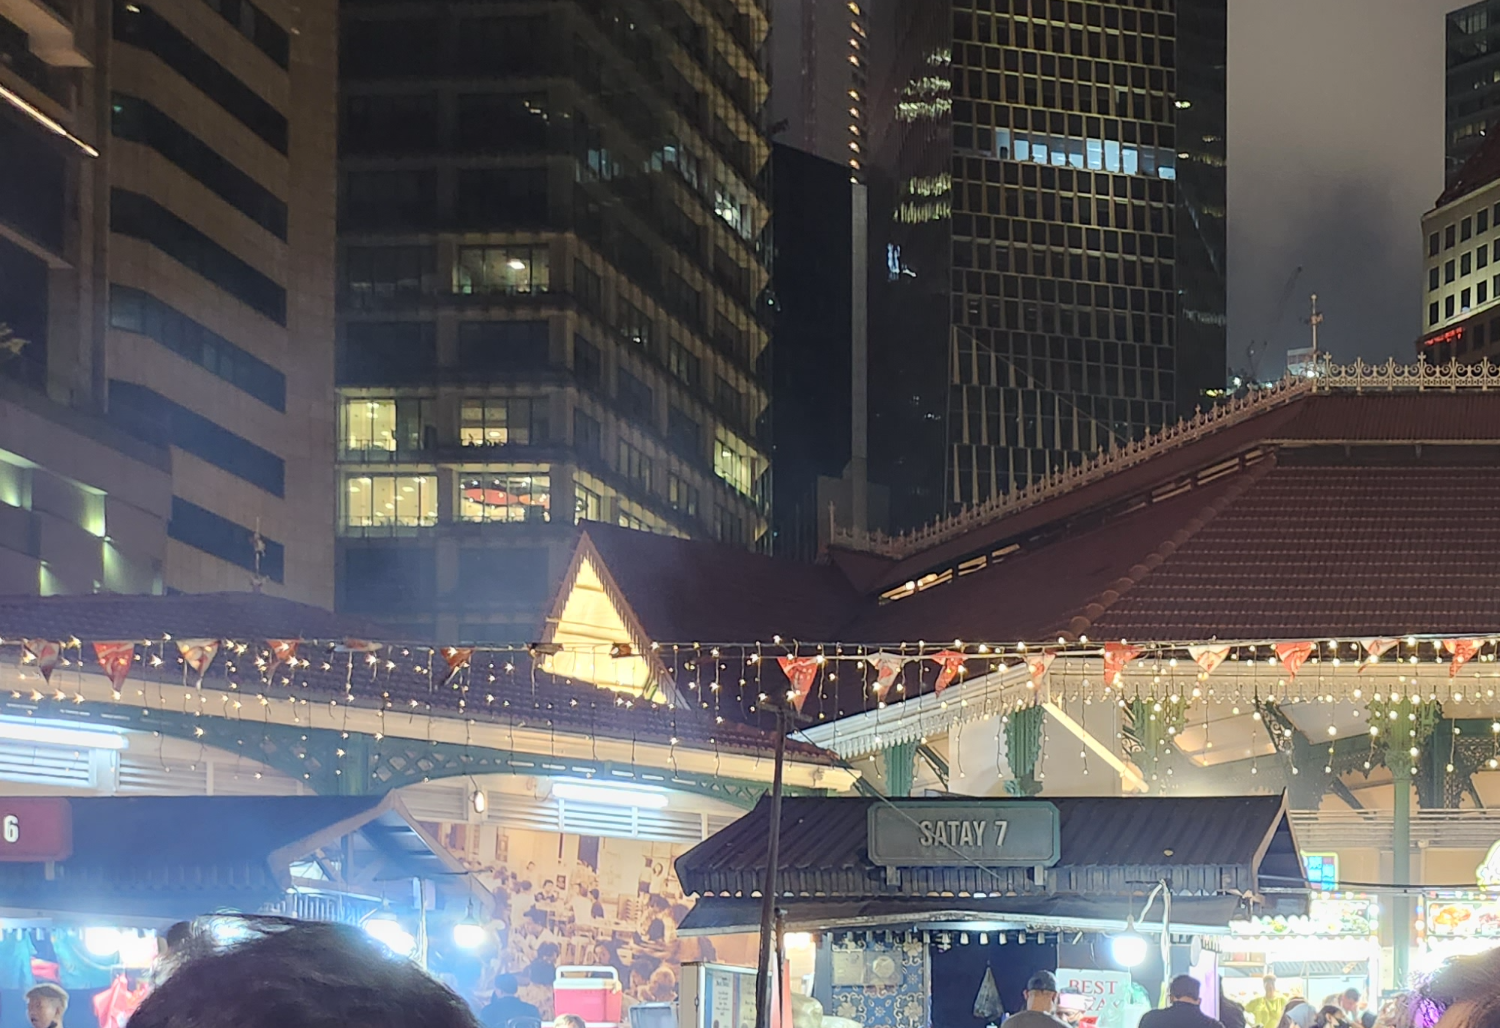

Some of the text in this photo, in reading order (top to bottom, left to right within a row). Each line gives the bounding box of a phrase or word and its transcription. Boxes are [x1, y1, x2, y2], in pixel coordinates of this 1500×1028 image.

[3, 814, 19, 843] 6
[919, 820, 1008, 847] SATAY 7
[1069, 979, 1118, 995] BEST
